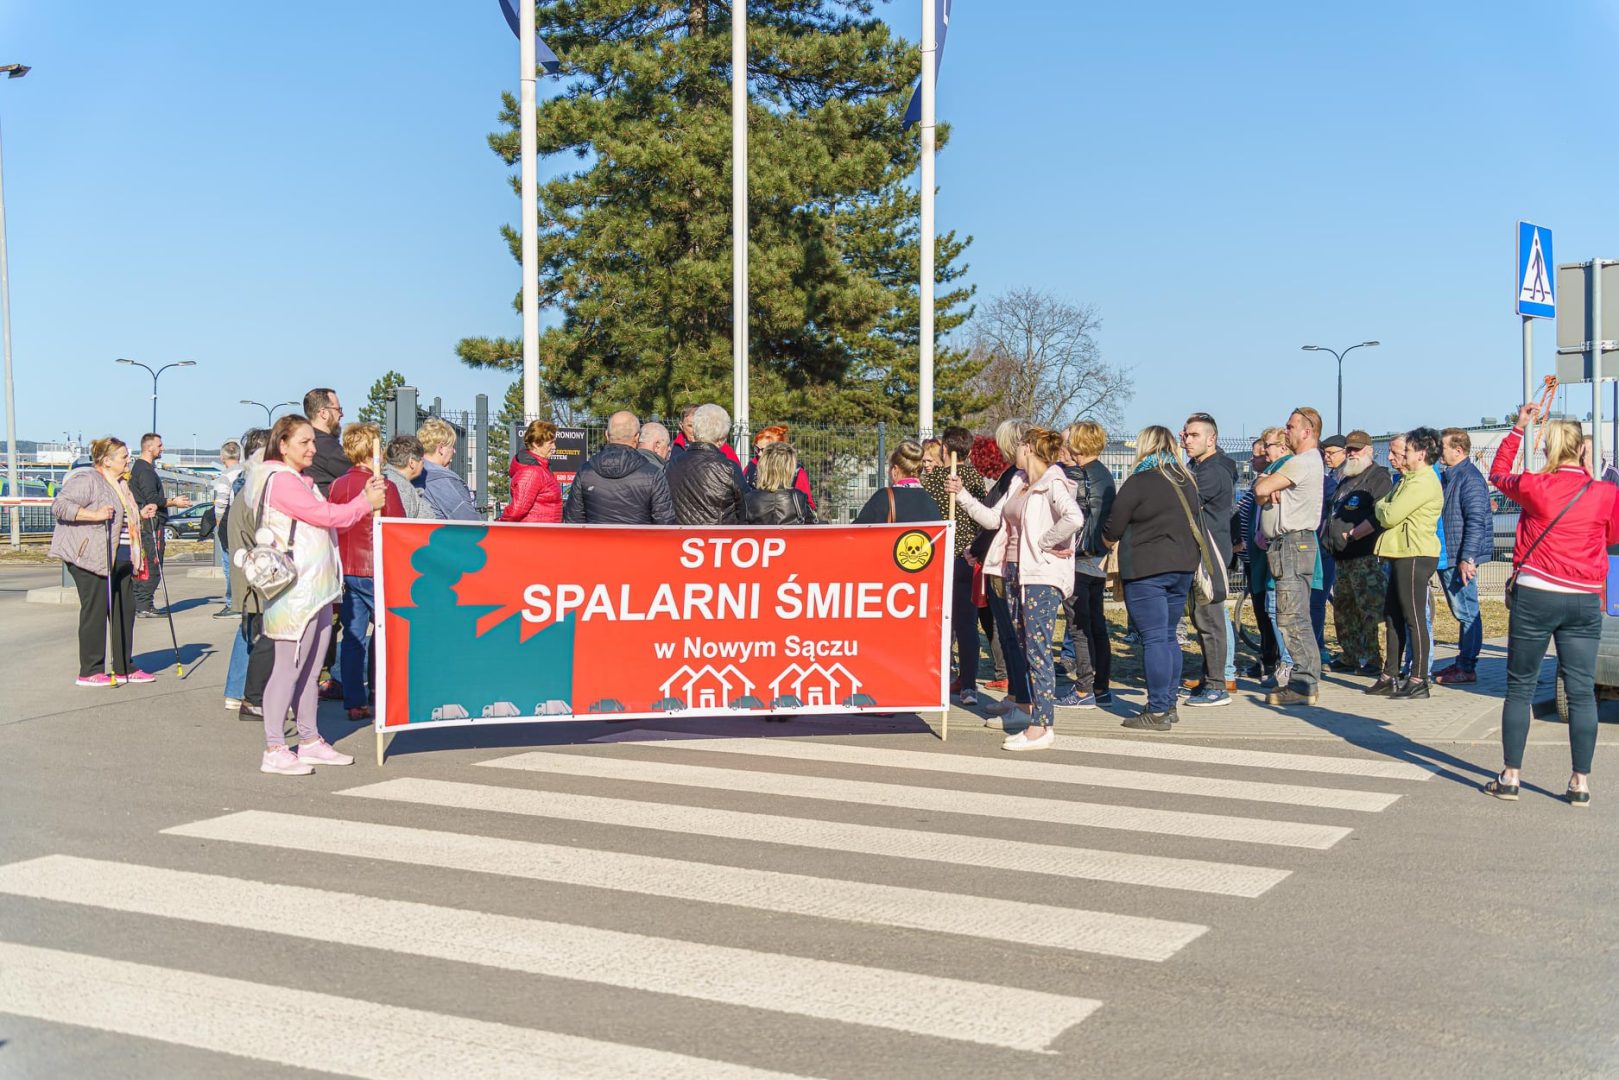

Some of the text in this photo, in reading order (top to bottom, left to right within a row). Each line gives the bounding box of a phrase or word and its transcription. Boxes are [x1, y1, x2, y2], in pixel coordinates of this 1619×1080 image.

[555, 431, 585, 439] RONIONY
[680, 537, 786, 569] STOP
[521, 574, 928, 622] SPALARNI ŚMIECI
[654, 635, 858, 663] w Nowym Sączu
